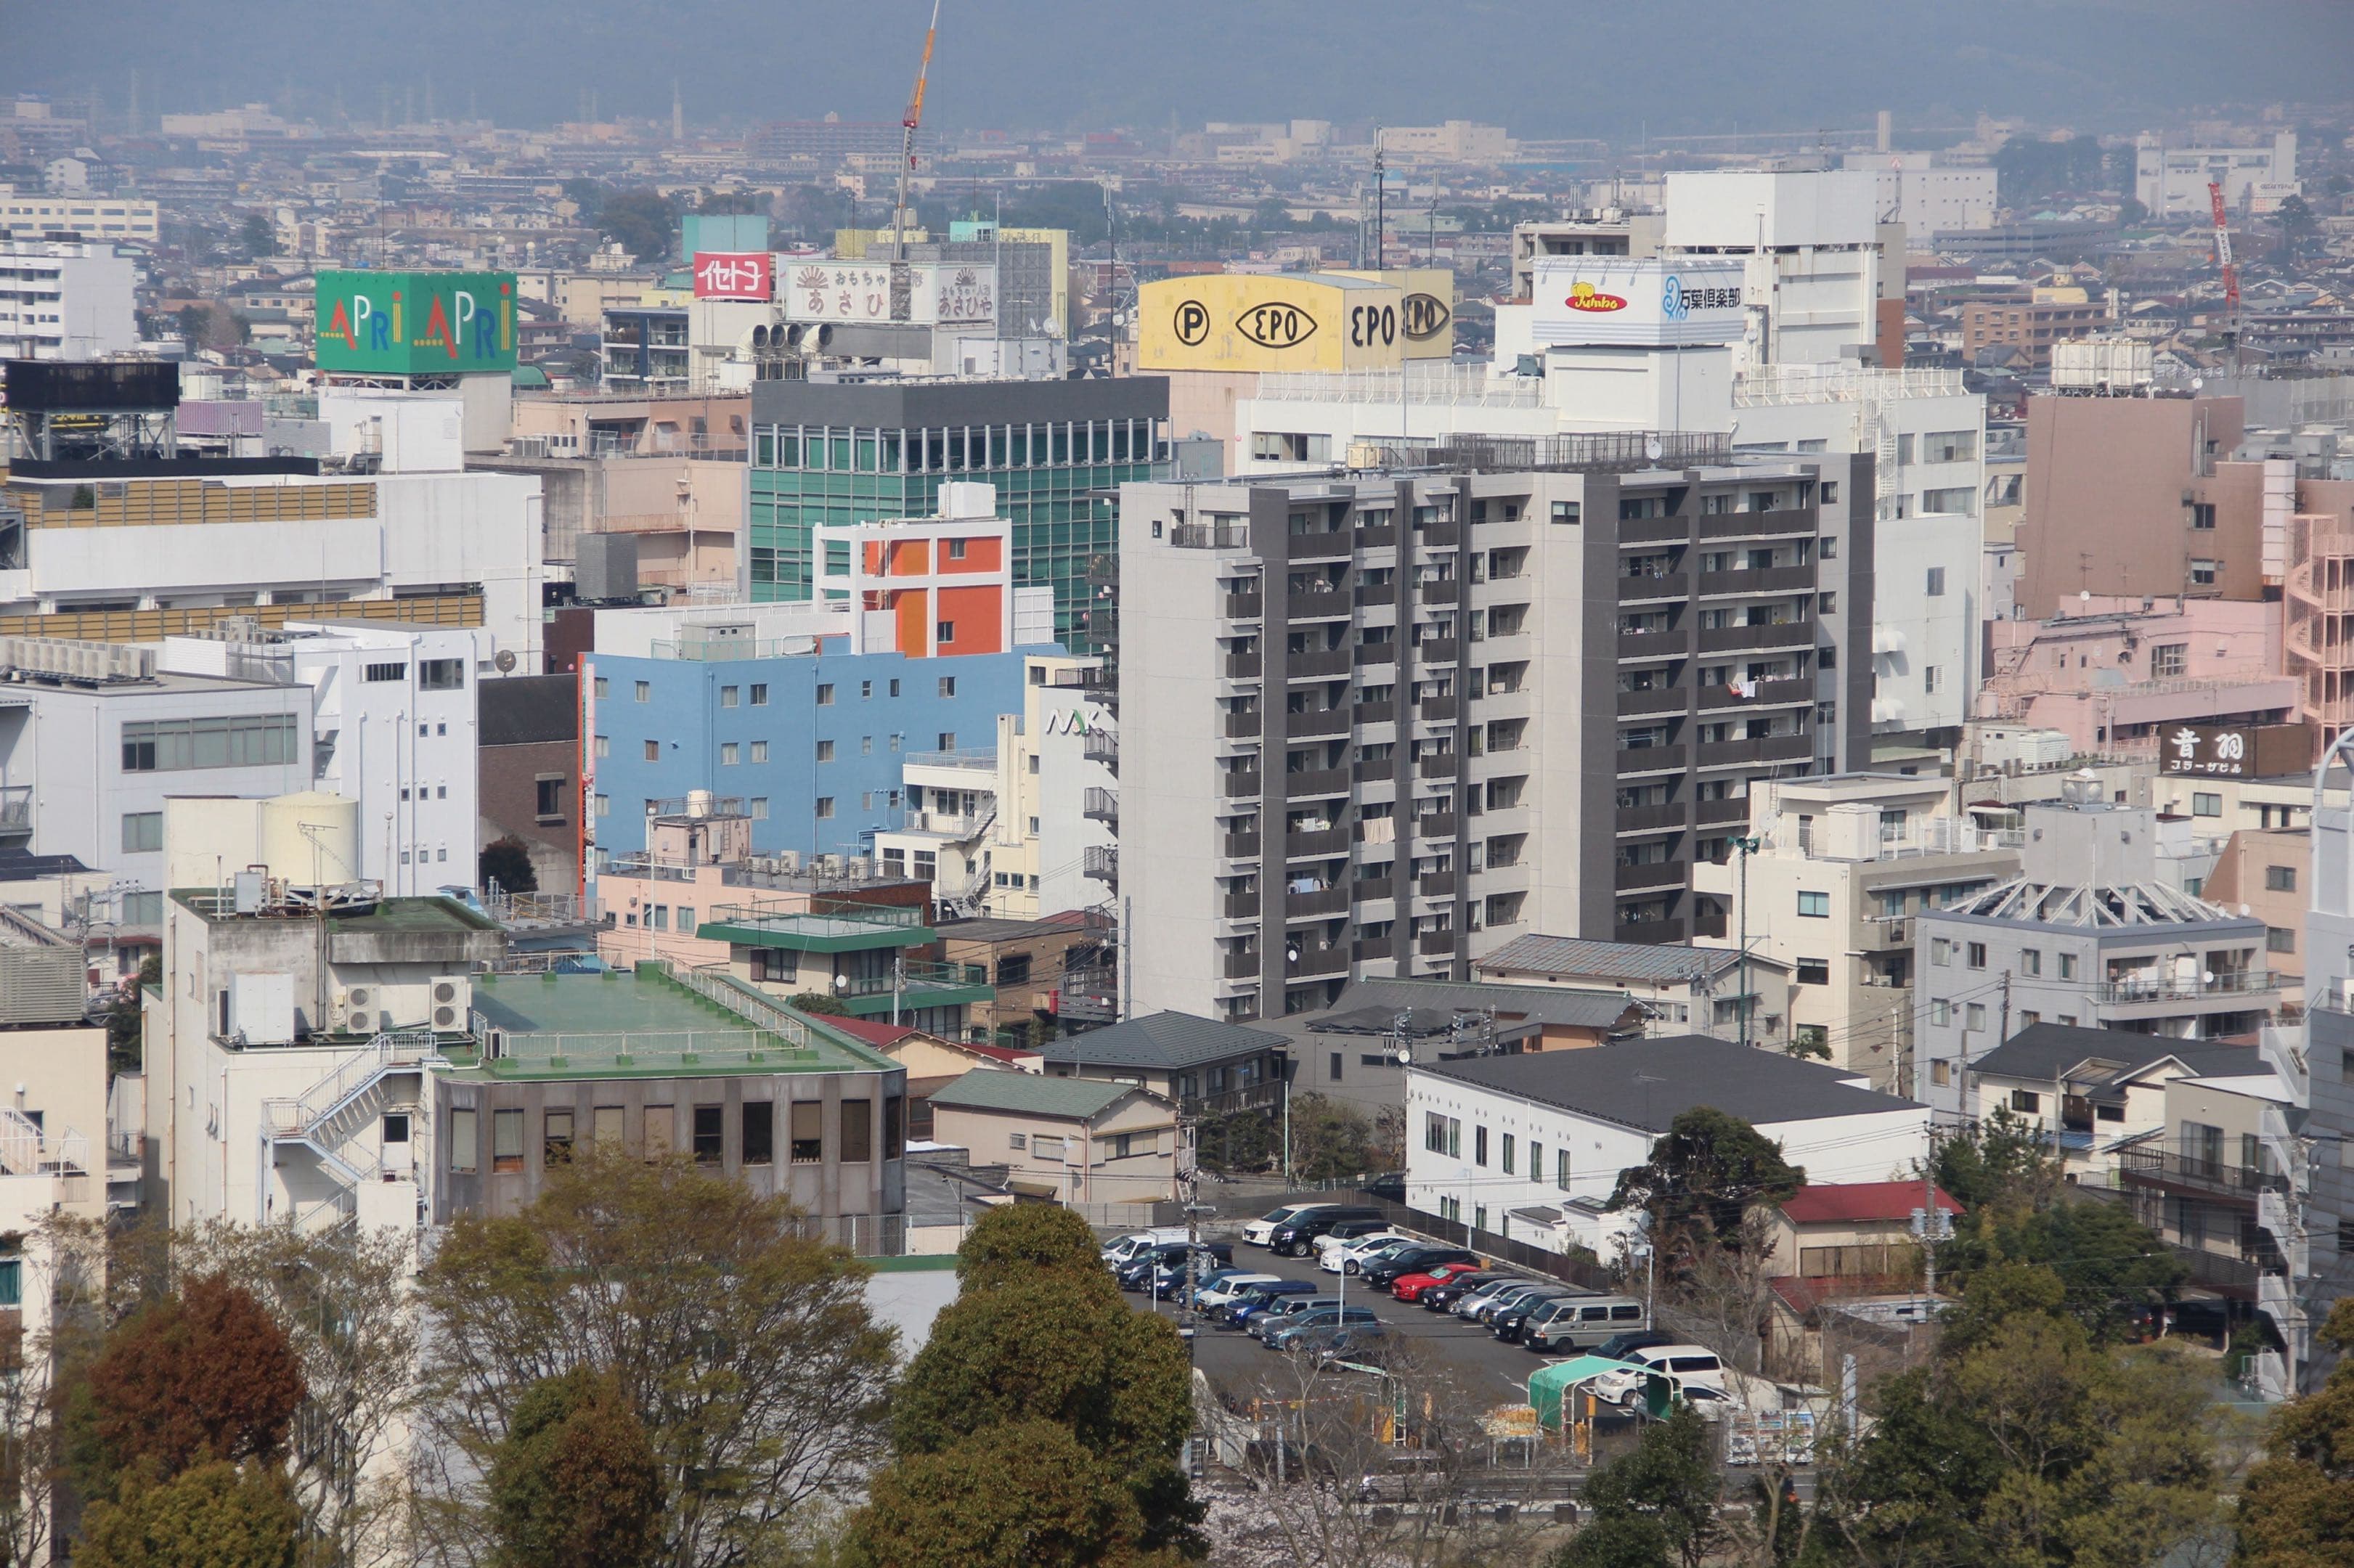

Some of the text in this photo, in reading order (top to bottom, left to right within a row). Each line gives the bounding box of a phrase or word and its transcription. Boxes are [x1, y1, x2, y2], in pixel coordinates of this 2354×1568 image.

[939, 295, 993, 317] あさひや
[1574, 294, 1618, 310] Jumbo
[1184, 308, 1203, 339] P
[2170, 727, 2244, 759] 音羽
